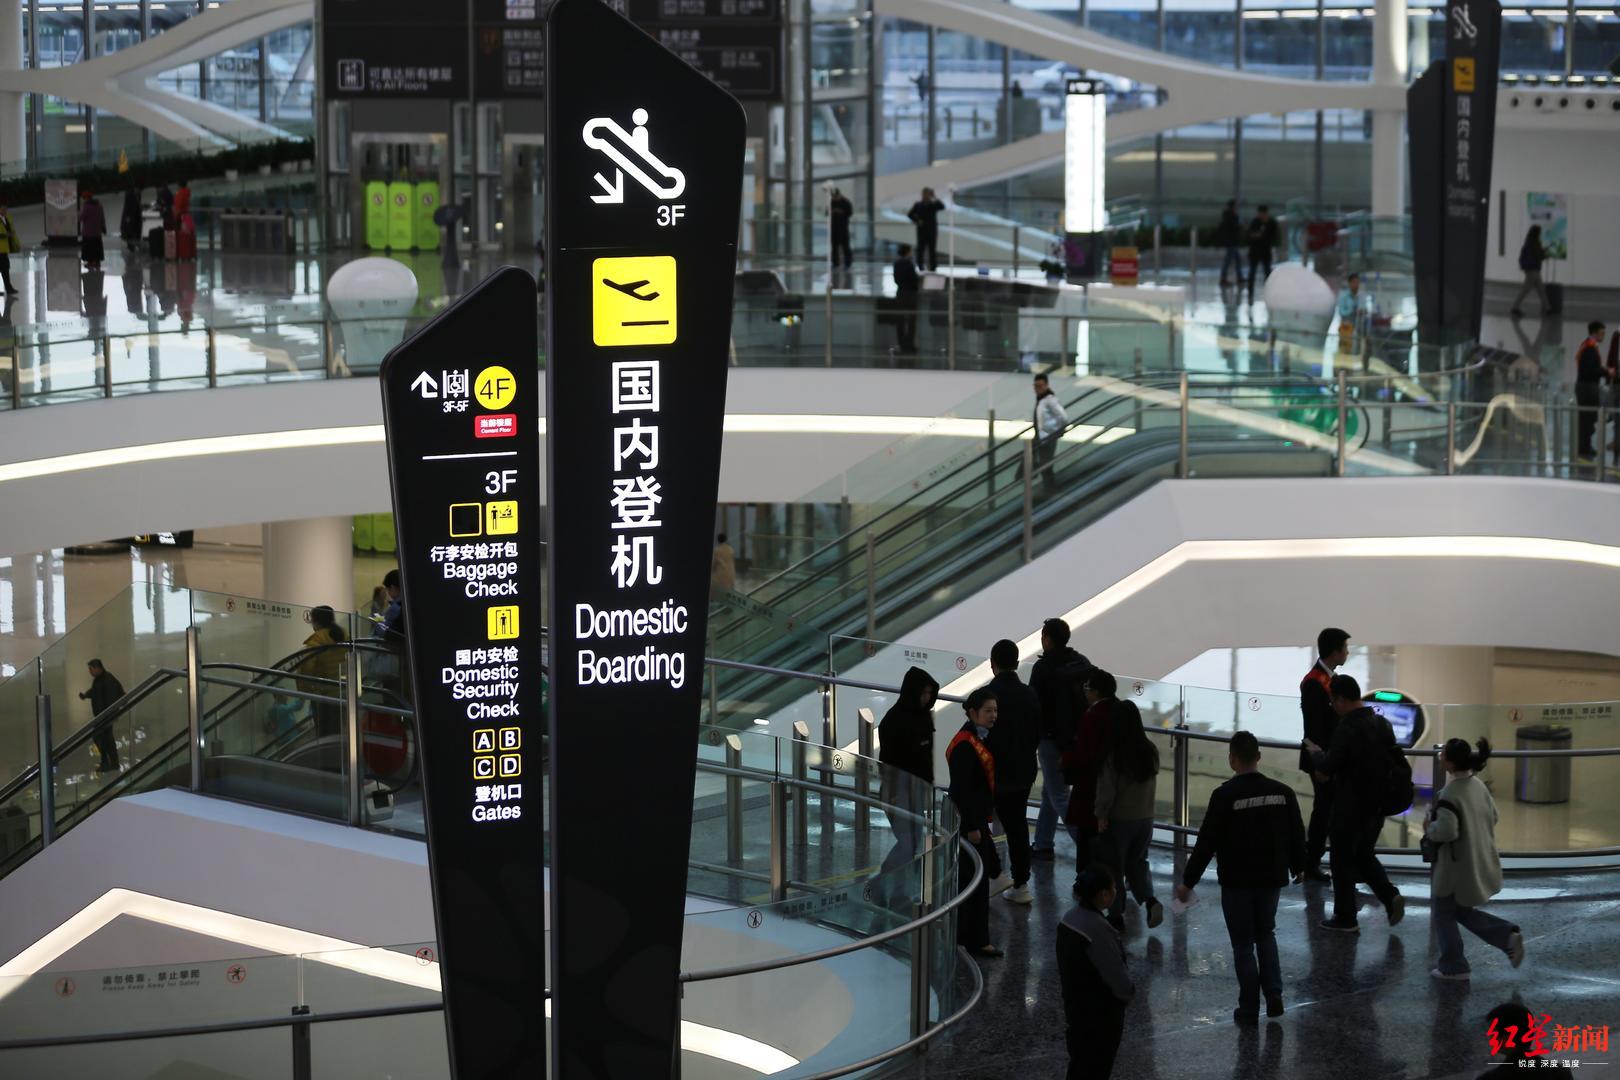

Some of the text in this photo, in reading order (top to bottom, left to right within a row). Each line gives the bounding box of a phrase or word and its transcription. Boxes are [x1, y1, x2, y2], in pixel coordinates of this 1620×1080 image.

[657, 205, 686, 227] 3F
[479, 378, 511, 400] 4F
[442, 400, 469, 413] 3F-5F
[485, 469, 518, 495] 3F
[610, 360, 663, 589] 国内登机
[430, 541, 519, 562] 行李安检开包
[443, 561, 518, 581] Baggage
[465, 579, 519, 598] Check
[575, 598, 689, 640] Domestic
[455, 645, 519, 666] 国内安检
[441, 664, 519, 684] Domestic
[577, 645, 686, 689] Boarding
[452, 681, 520, 700] Security
[466, 700, 520, 720] Check
[477, 730, 516, 749] A B
[477, 757, 518, 776] C D
[475, 784, 522, 803] 登机口
[472, 804, 522, 822] Gates
